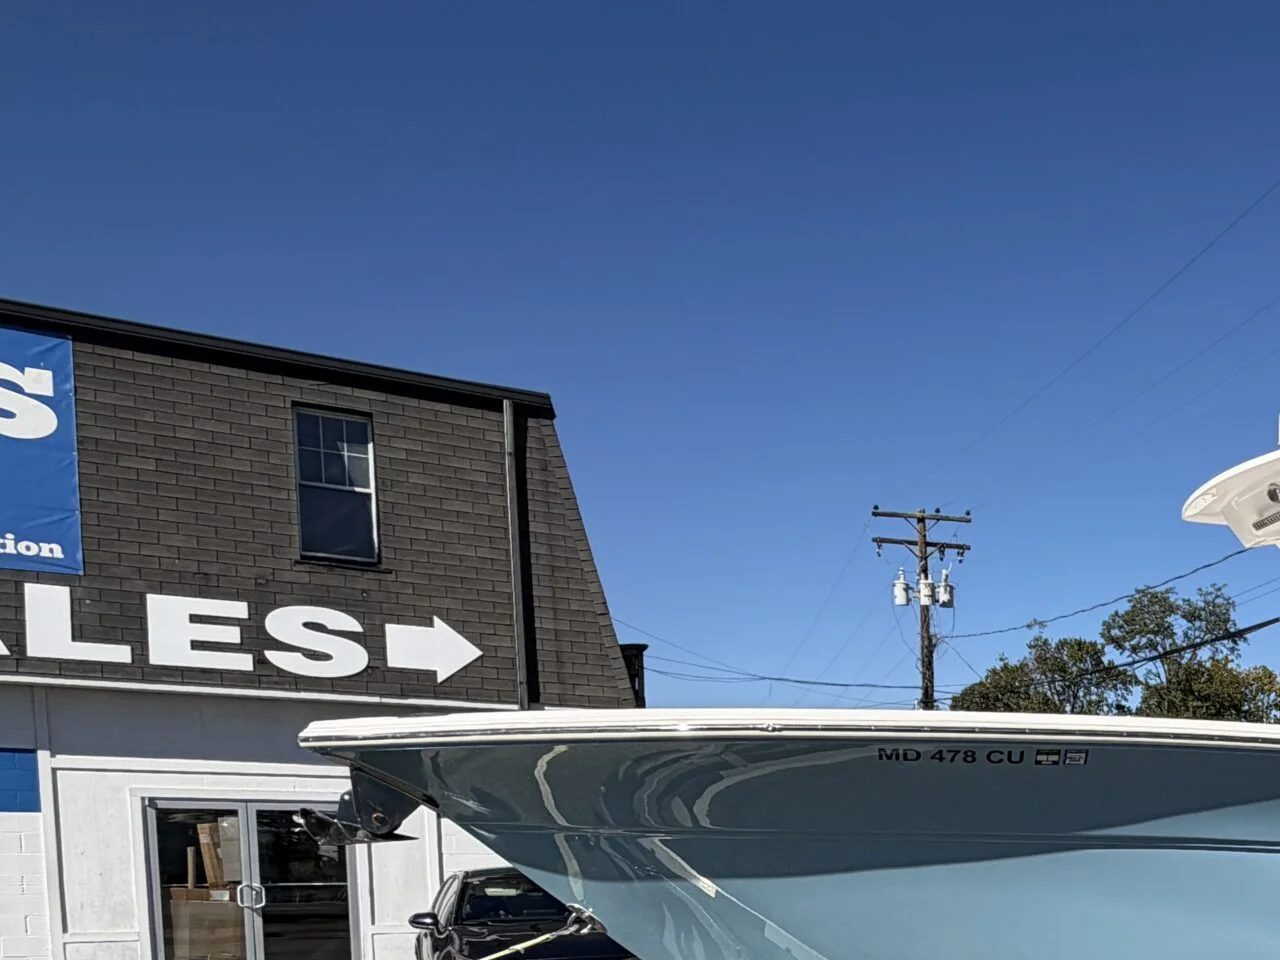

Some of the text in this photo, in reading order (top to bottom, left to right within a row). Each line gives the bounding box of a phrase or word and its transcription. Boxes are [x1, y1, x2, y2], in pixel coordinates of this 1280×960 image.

[0, 533, 64, 559] ion
[0, 583, 369, 678] LES
[878, 748, 922, 762] MD
[930, 749, 977, 764] 478
[986, 750, 1025, 765] CU
